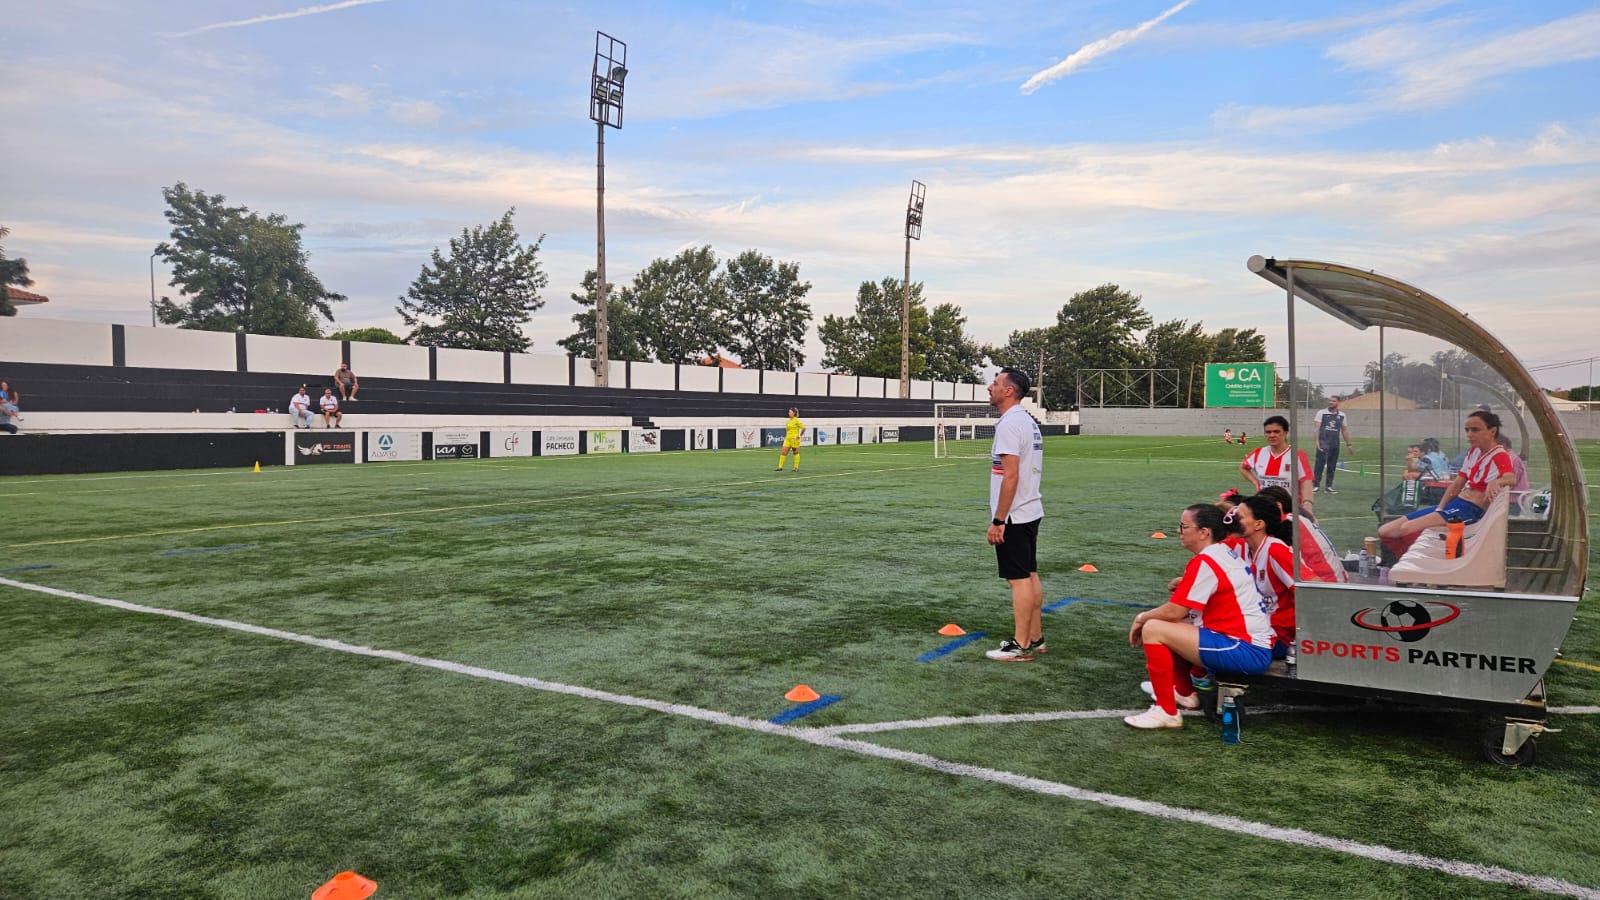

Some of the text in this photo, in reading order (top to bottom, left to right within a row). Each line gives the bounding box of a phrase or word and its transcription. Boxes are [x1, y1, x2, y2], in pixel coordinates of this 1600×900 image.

[1238, 368, 1261, 382] CA
[436, 446, 456, 454] KIA
[546, 442, 575, 450] PACHECO
[1301, 639, 1537, 675] SPORTS PARTNER
